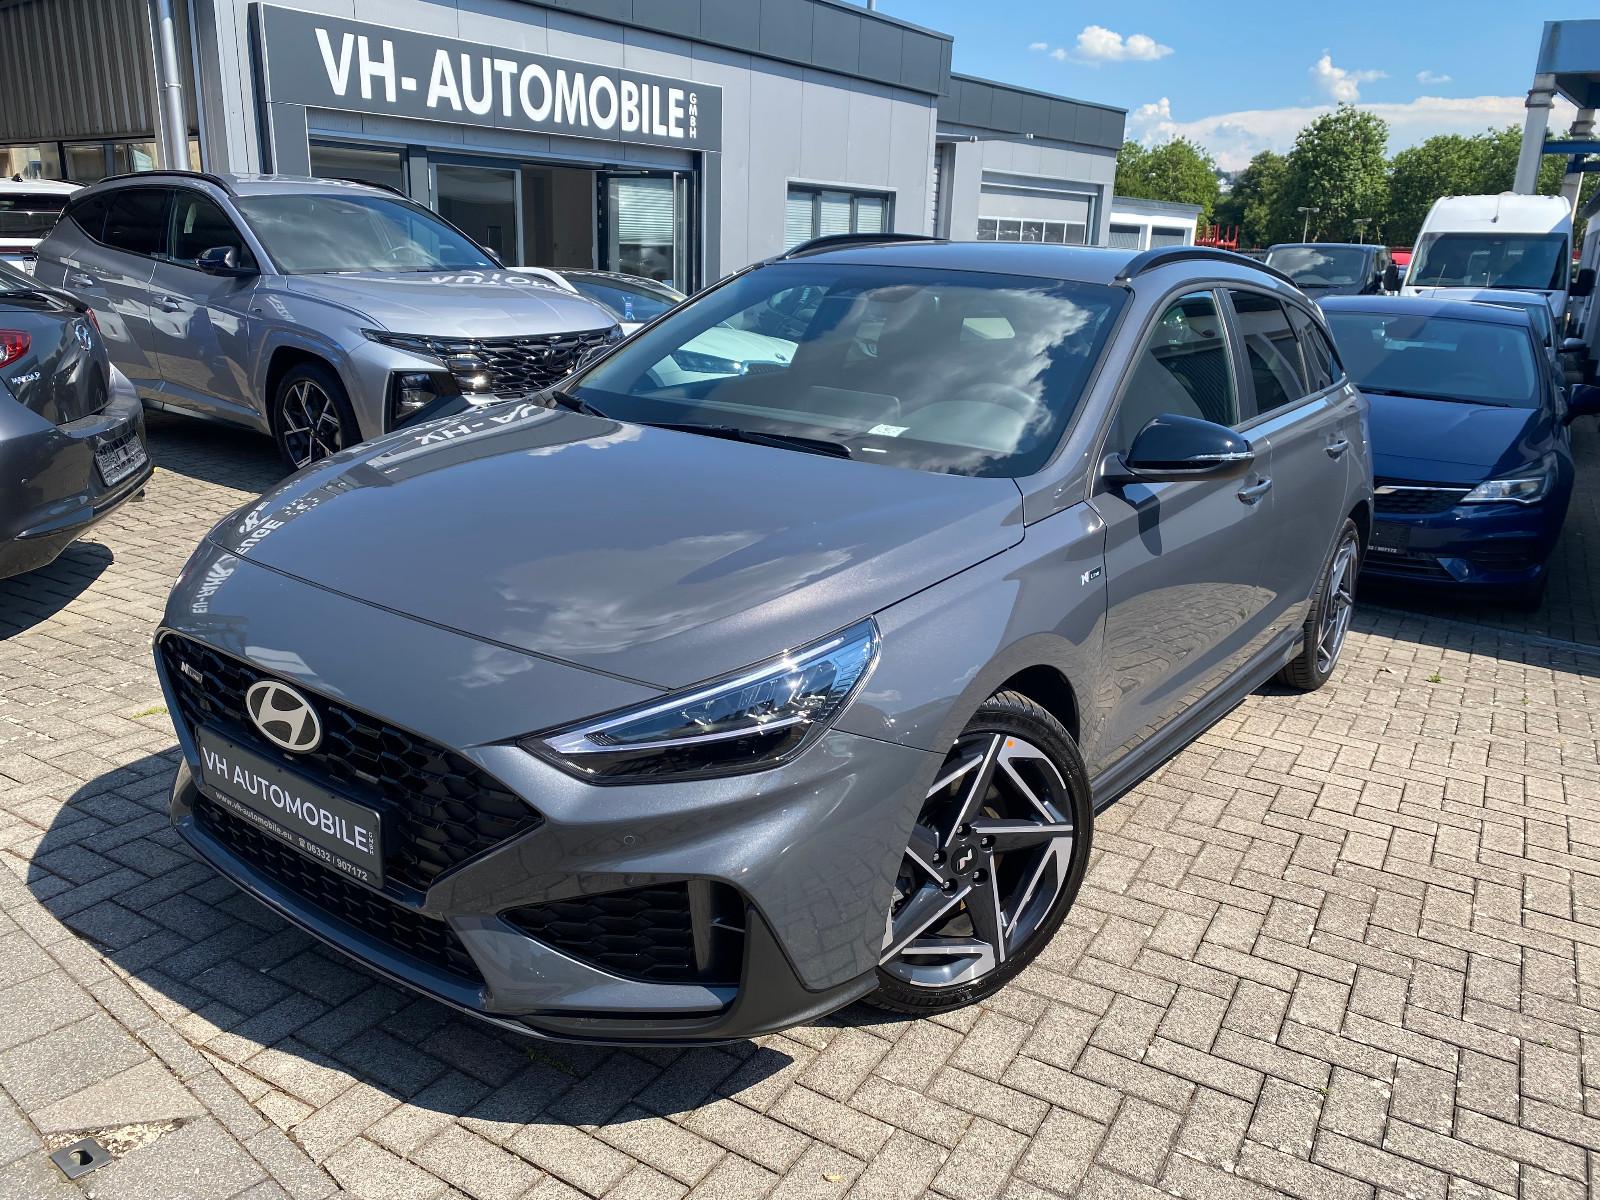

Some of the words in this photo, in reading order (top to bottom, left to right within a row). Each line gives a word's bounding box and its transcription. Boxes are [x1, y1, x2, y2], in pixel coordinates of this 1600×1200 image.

[315, 28, 416, 102] VH-
[427, 49, 685, 138] AUTOMOBILE
[688, 92, 698, 139] GMBH
[203, 747, 229, 779] VH
[233, 765, 369, 853] AUTOMOBILE
[215, 791, 293, 840] www.vh-automobile.eu
[306, 842, 331, 862] 06332
[336, 858, 368, 881] 907172
